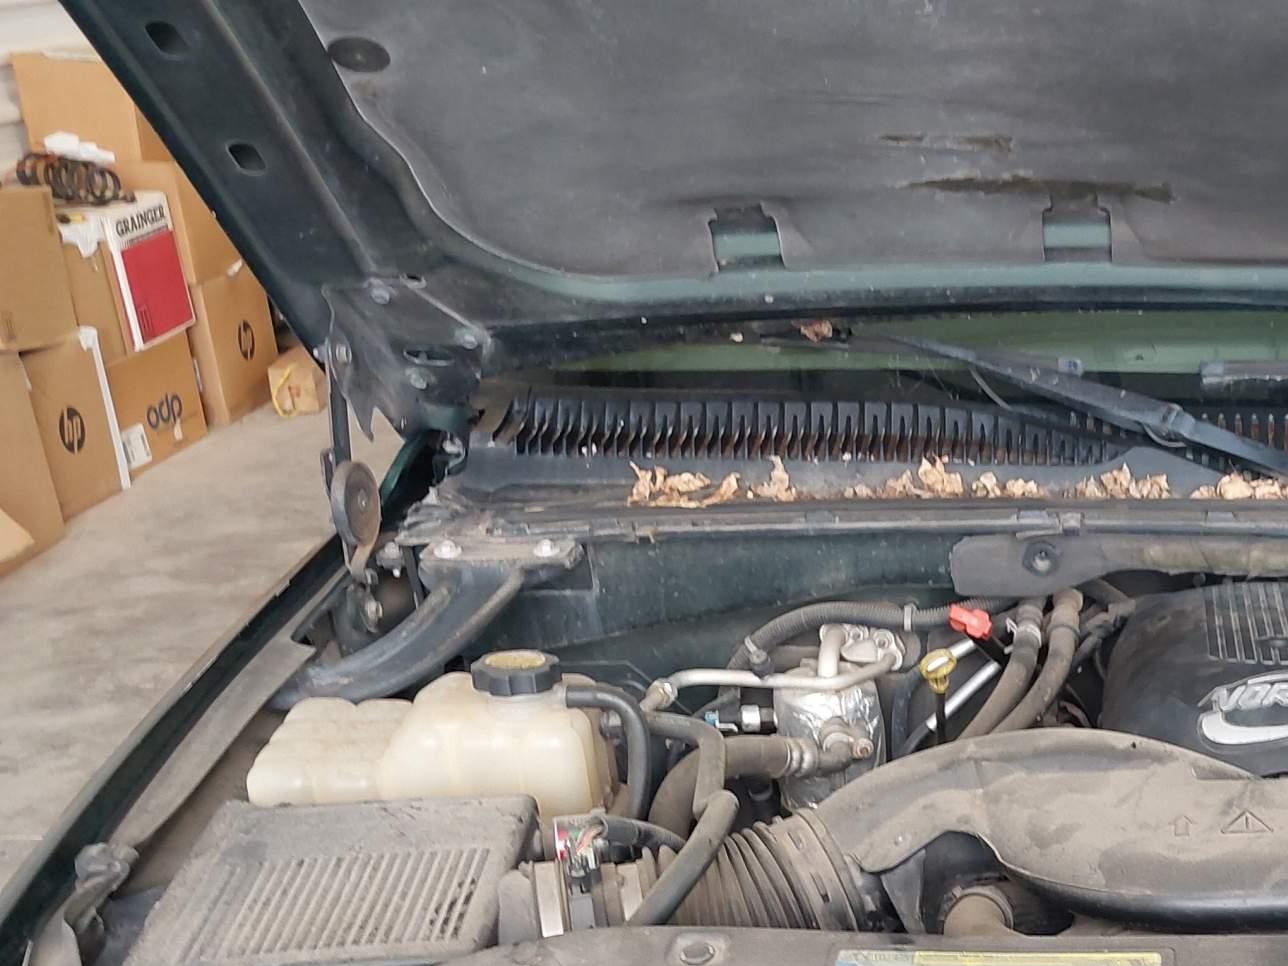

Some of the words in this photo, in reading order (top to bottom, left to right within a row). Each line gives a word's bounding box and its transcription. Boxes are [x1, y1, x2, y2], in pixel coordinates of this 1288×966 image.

[115, 203, 166, 237] GRAINGER
[59, 406, 86, 454] hp
[146, 393, 182, 430] odp
